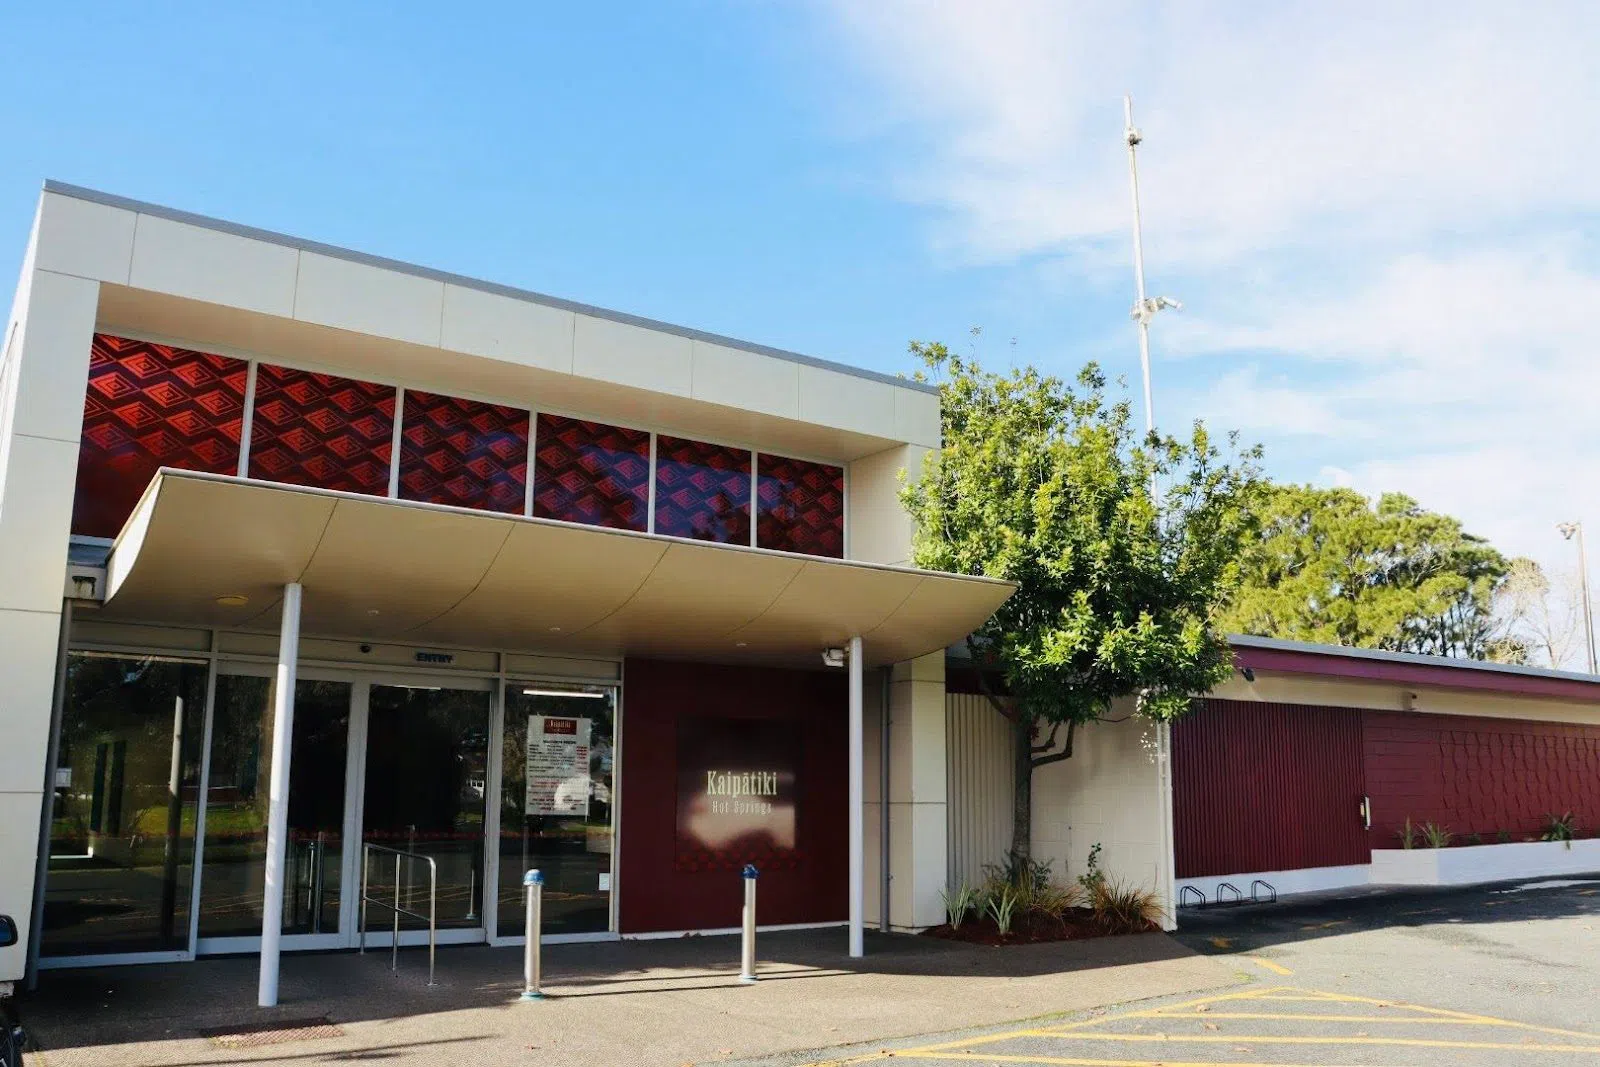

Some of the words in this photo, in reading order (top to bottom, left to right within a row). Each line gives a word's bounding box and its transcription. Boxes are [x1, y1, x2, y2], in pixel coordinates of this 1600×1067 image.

[416, 652, 453, 663] ENTRY
[706, 770, 777, 798] Kaipātiki
[712, 800, 729, 814] Hot
[734, 800, 772, 815] Springs
